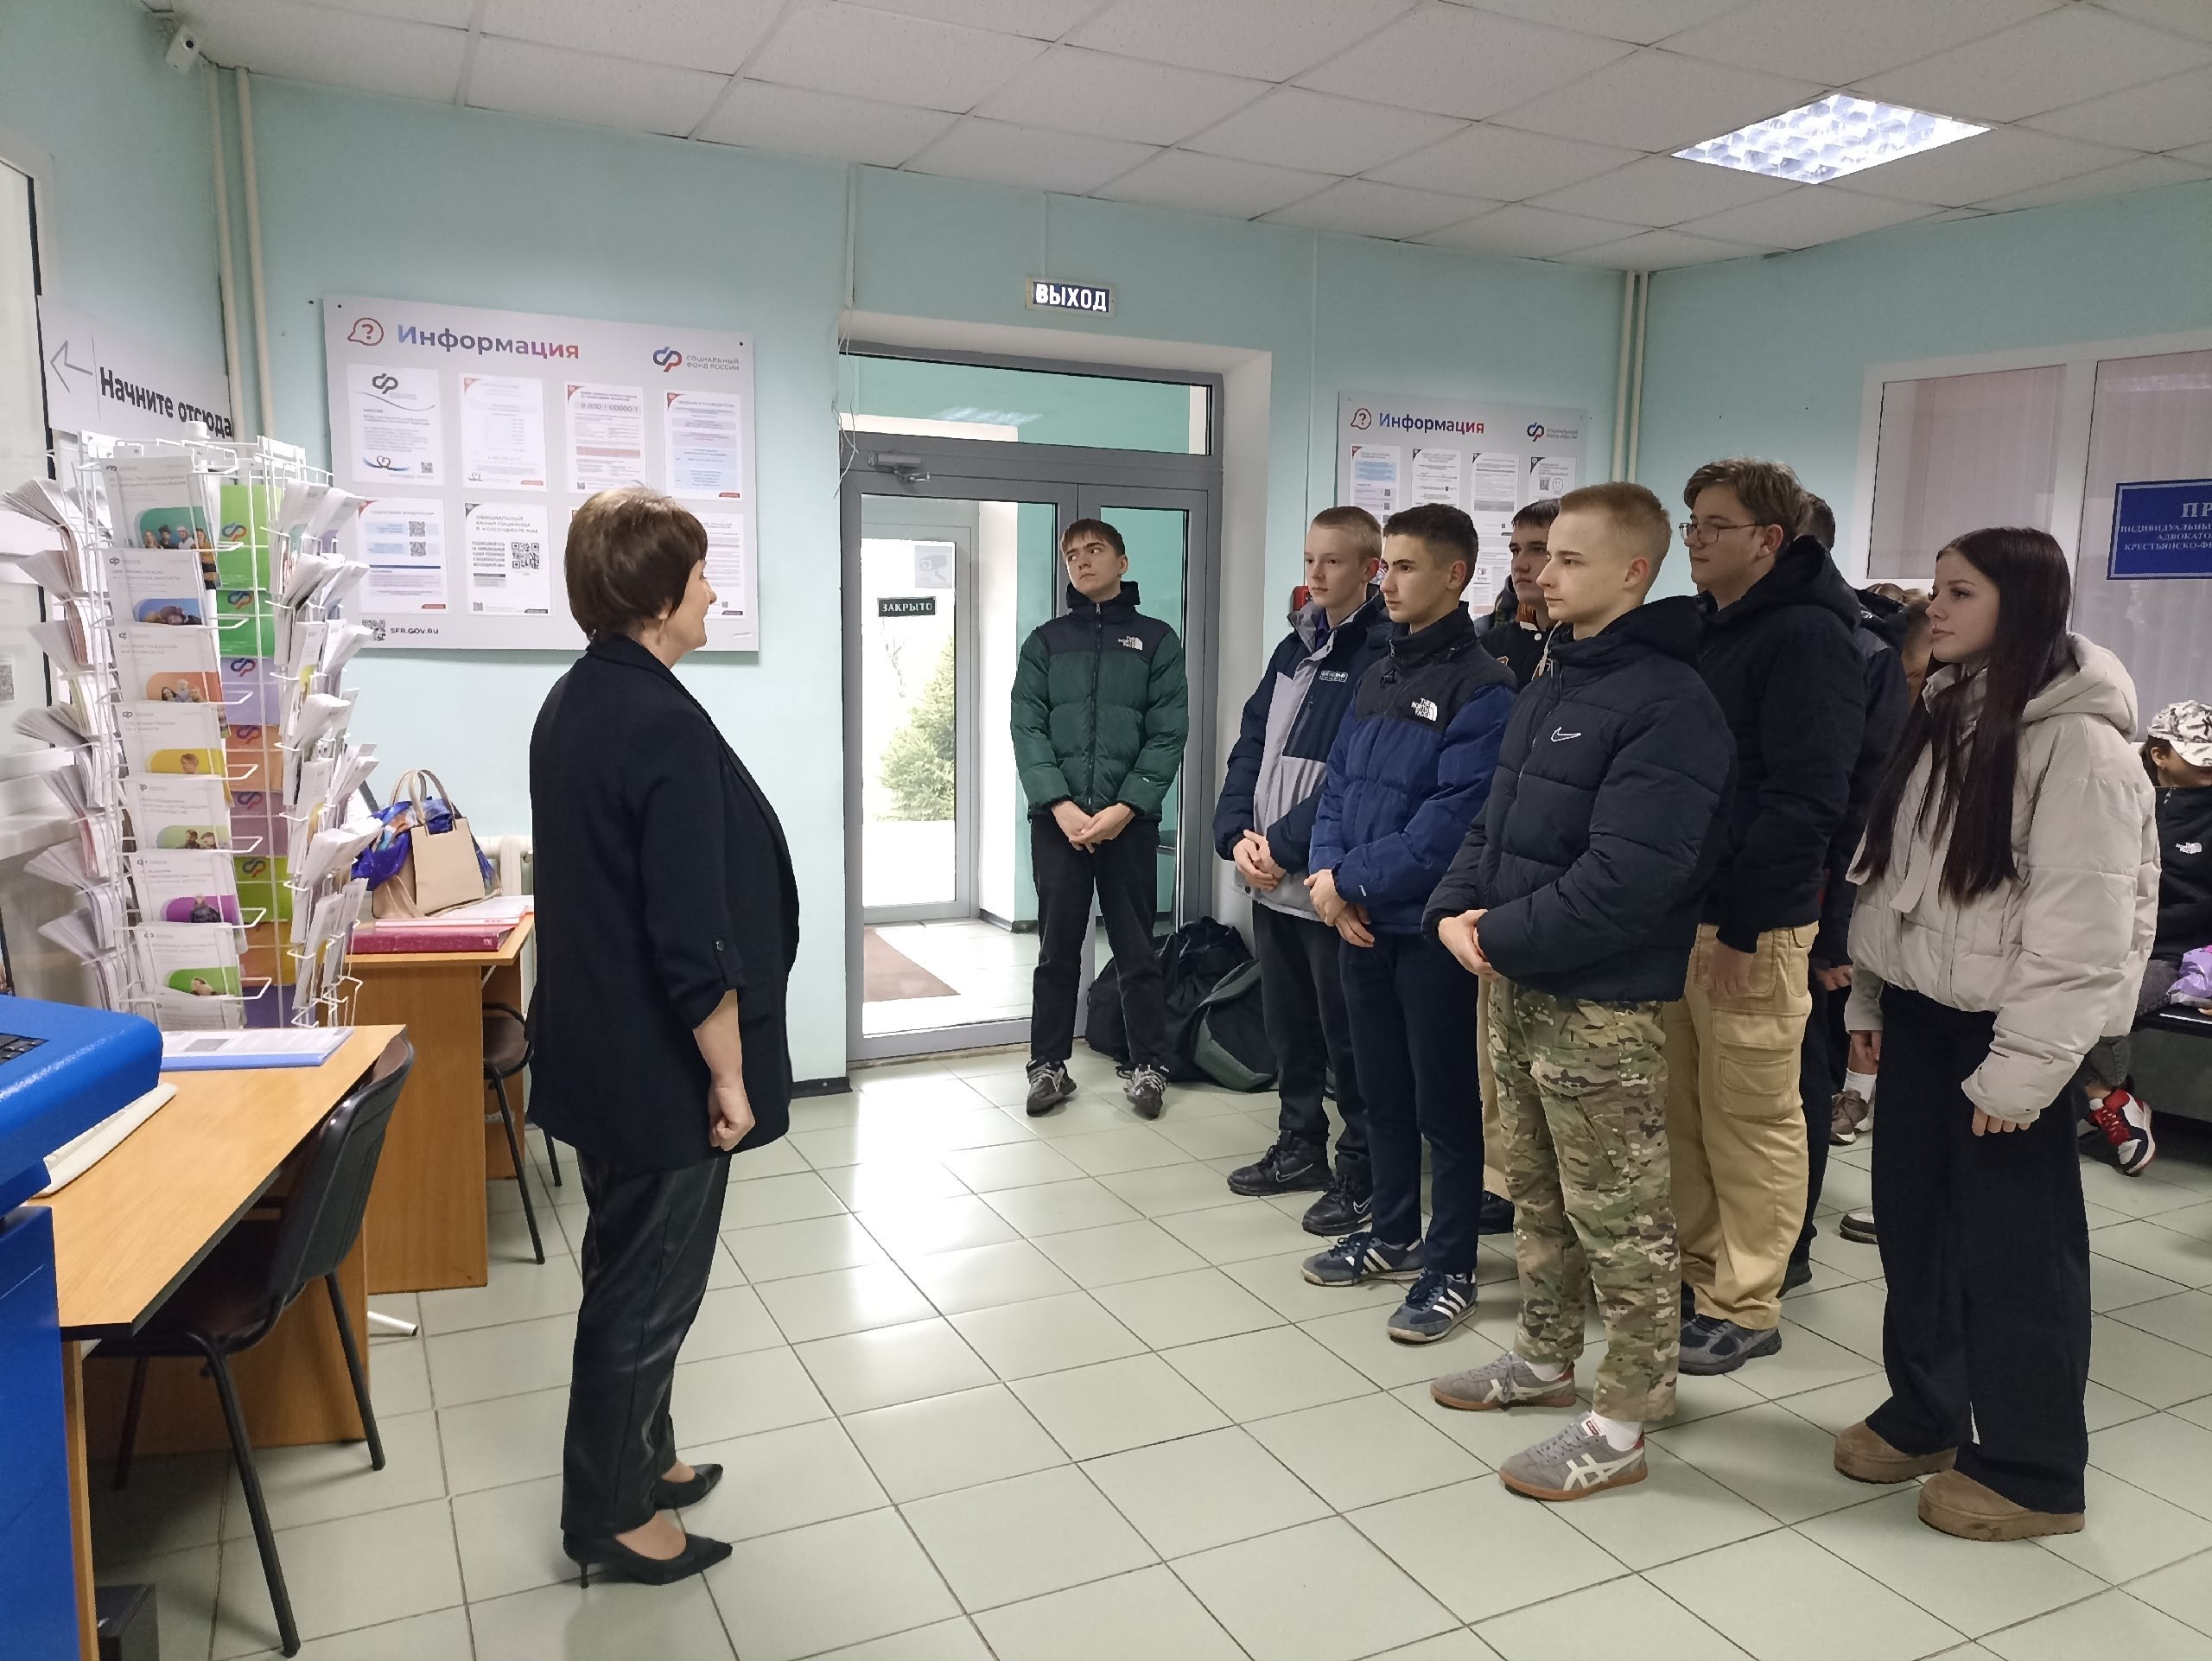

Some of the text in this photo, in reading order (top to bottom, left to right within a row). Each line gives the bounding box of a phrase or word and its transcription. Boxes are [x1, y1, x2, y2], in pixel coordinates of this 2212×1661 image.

[1035, 283, 1107, 312] ВЫХОД
[397, 324, 579, 360] Информация
[99, 366, 174, 418] Начните
[1379, 412, 1485, 435] Информация
[881, 603, 932, 612] ЗАКРЫТО
